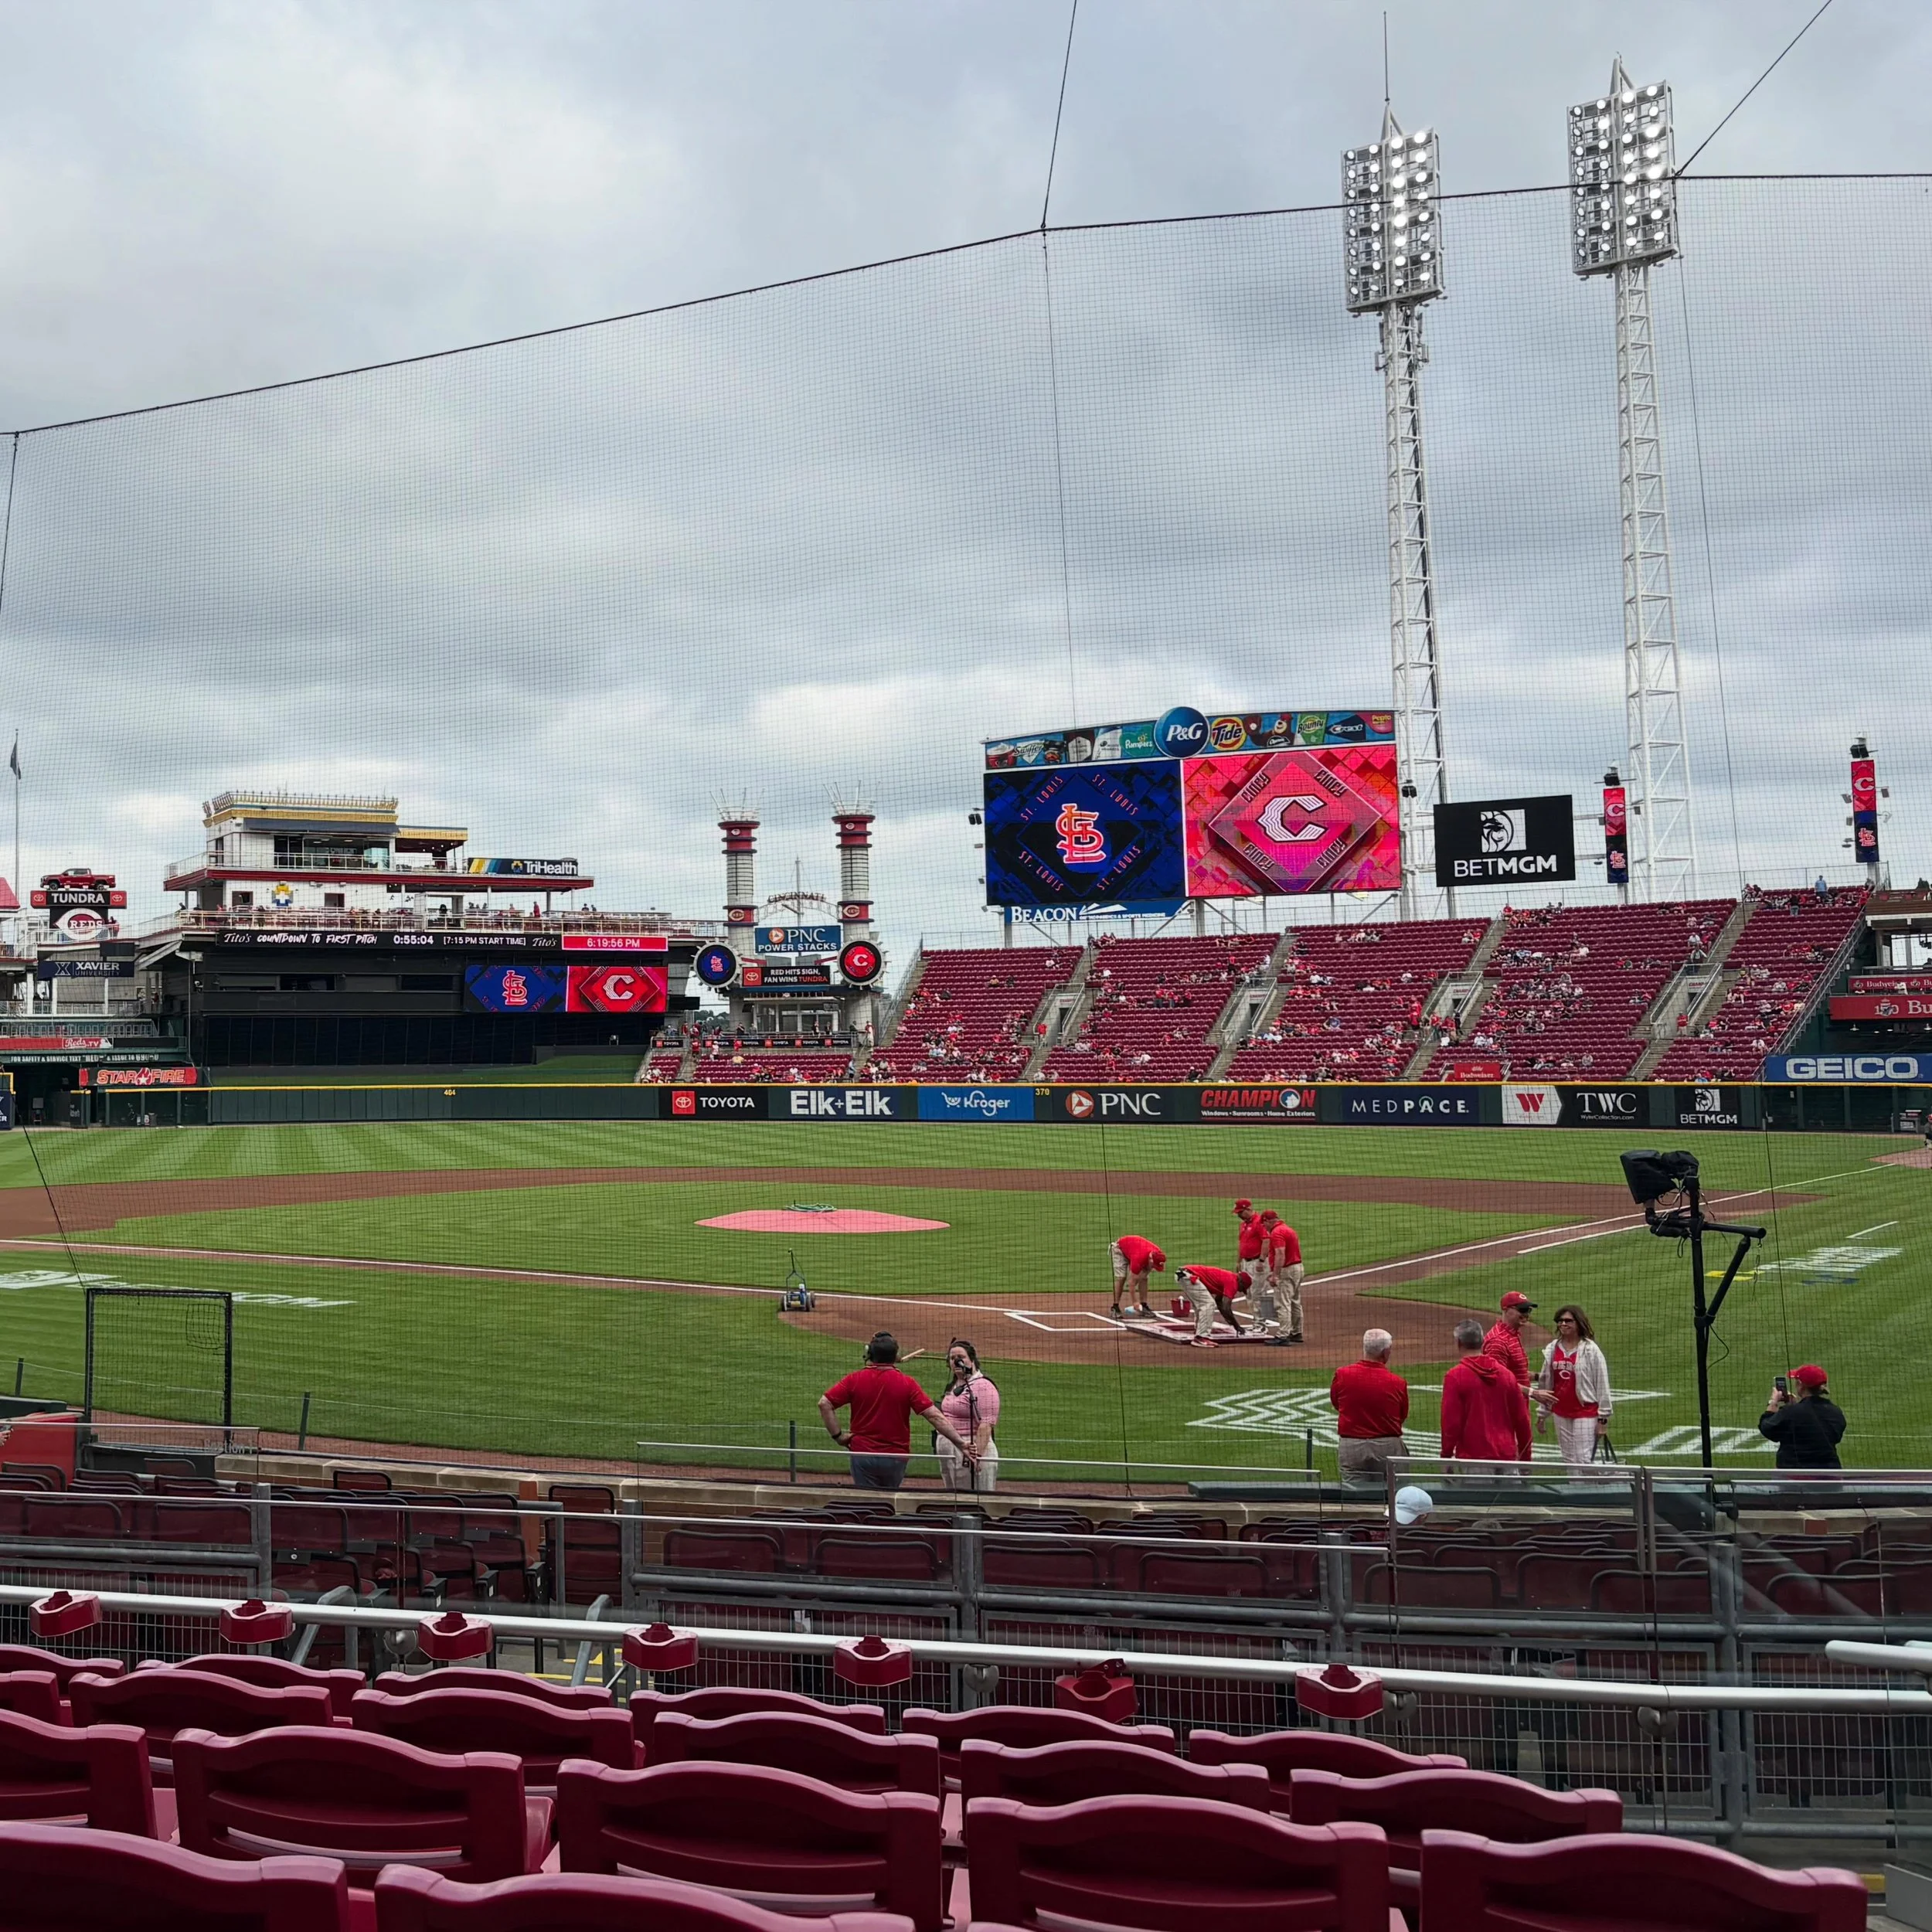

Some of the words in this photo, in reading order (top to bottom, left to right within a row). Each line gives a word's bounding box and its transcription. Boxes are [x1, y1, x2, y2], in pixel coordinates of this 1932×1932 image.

[1166, 723, 1202, 742] P&G
[1297, 719, 1324, 734] Bounty
[1212, 726, 1243, 746] Tide
[1013, 741, 1044, 756] Swiffer
[1124, 739, 1153, 750] Pampers
[1020, 807, 1037, 821] ST.
[1036, 776, 1063, 803] LOUIS
[1092, 774, 1107, 791] ST.
[1109, 789, 1138, 815] LOUIS
[524, 861, 577, 875] TriHealth
[1019, 850, 1032, 867] ST.
[1036, 866, 1064, 891] LOUIS
[1097, 877, 1115, 890] ST.
[1113, 845, 1141, 874] LOUIS
[1454, 855, 1557, 878] BETMGM
[51, 893, 105, 903] TUNDRA
[1011, 906, 1077, 923] BEACON
[70, 920, 103, 929] REDS
[223, 933, 251, 943] Tito's
[257, 933, 308, 944] COUNTDOWN
[311, 933, 321, 944] TO
[325, 934, 356, 944] FIRST
[355, 934, 378, 944] PITCH
[393, 934, 434, 944] 0:55:04
[443, 936, 464, 945] [7:15
[464, 936, 478, 944] PM
[478, 937, 503, 945] START
[505, 937, 526, 946] TIME]
[532, 937, 557, 947] Tito's
[587, 937, 623, 947] 6:19:56
[625, 938, 640, 947] PM
[787, 928, 826, 943] PNC
[758, 944, 794, 952] POWER
[797, 942, 837, 951] STACKS
[75, 961, 120, 971] XAVIER
[1786, 1056, 1919, 1080] GEICO
[97, 1070, 136, 1084] STAR
[150, 1069, 185, 1083] FIRE
[700, 1097, 756, 1108] TOYOTA
[791, 1090, 893, 1115] Elk+Elk
[964, 1090, 1010, 1116] Kroger
[1098, 1093, 1161, 1115] PNC
[1201, 1088, 1317, 1109] CHAMPION
[1352, 1096, 1468, 1114] MEDPACE
[1515, 1093, 1545, 1113] W
[1577, 1093, 1637, 1113] TWC
[1680, 1114, 1738, 1124] BETMGM
